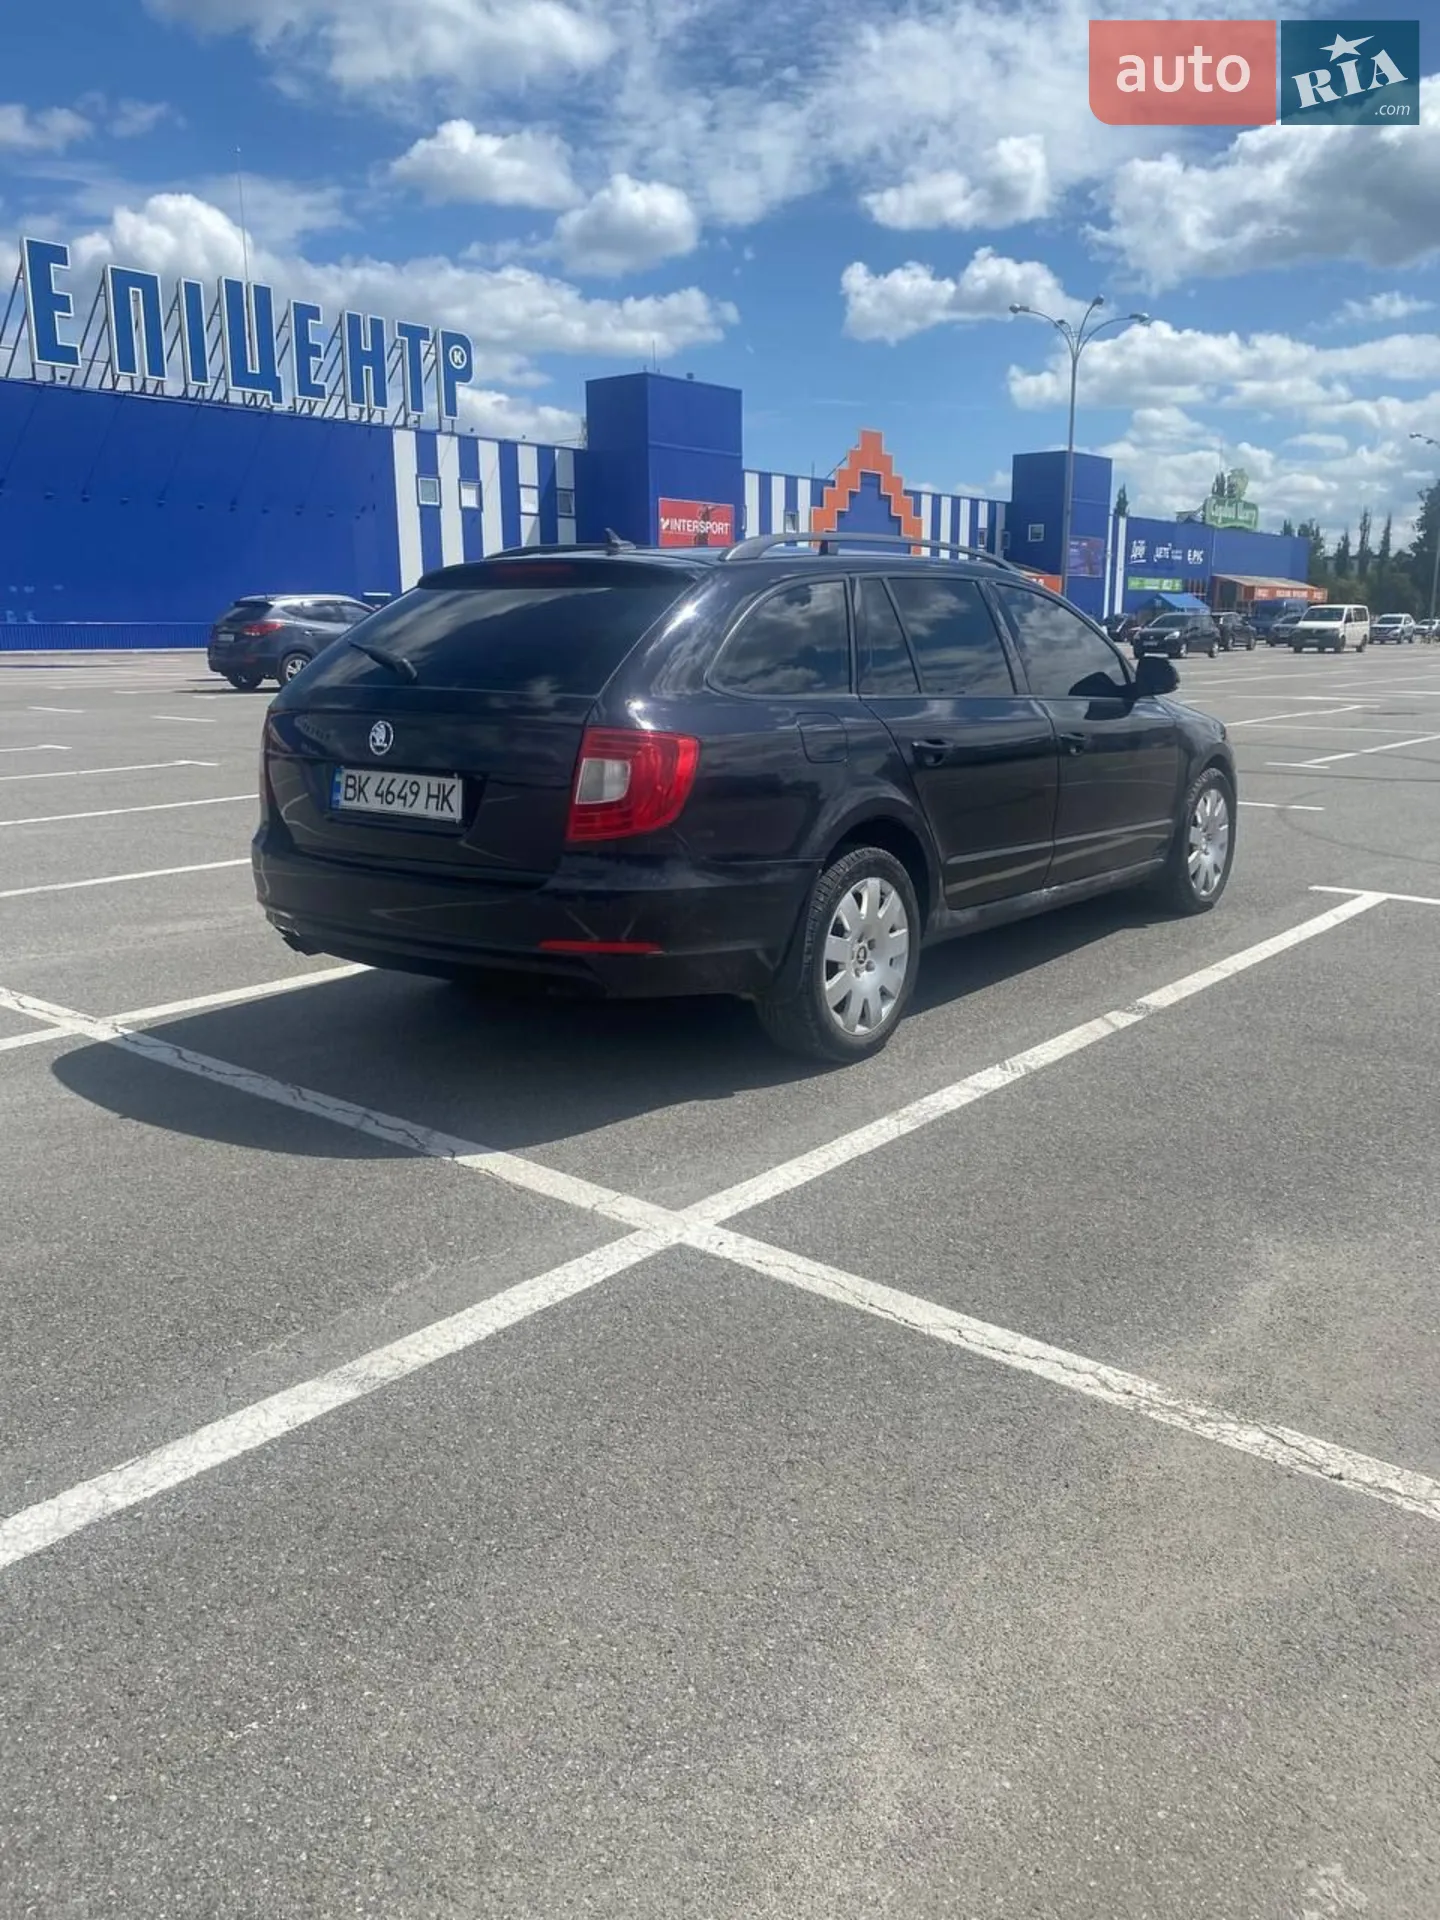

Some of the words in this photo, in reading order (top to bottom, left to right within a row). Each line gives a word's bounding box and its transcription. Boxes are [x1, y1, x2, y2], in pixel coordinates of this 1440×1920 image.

[21, 237, 474, 420] ЕПІЦЕНТР
[670, 518, 730, 535] INTERSPORT
[344, 774, 372, 804] BK
[375, 777, 420, 808] 4649
[424, 782, 456, 812] HK
